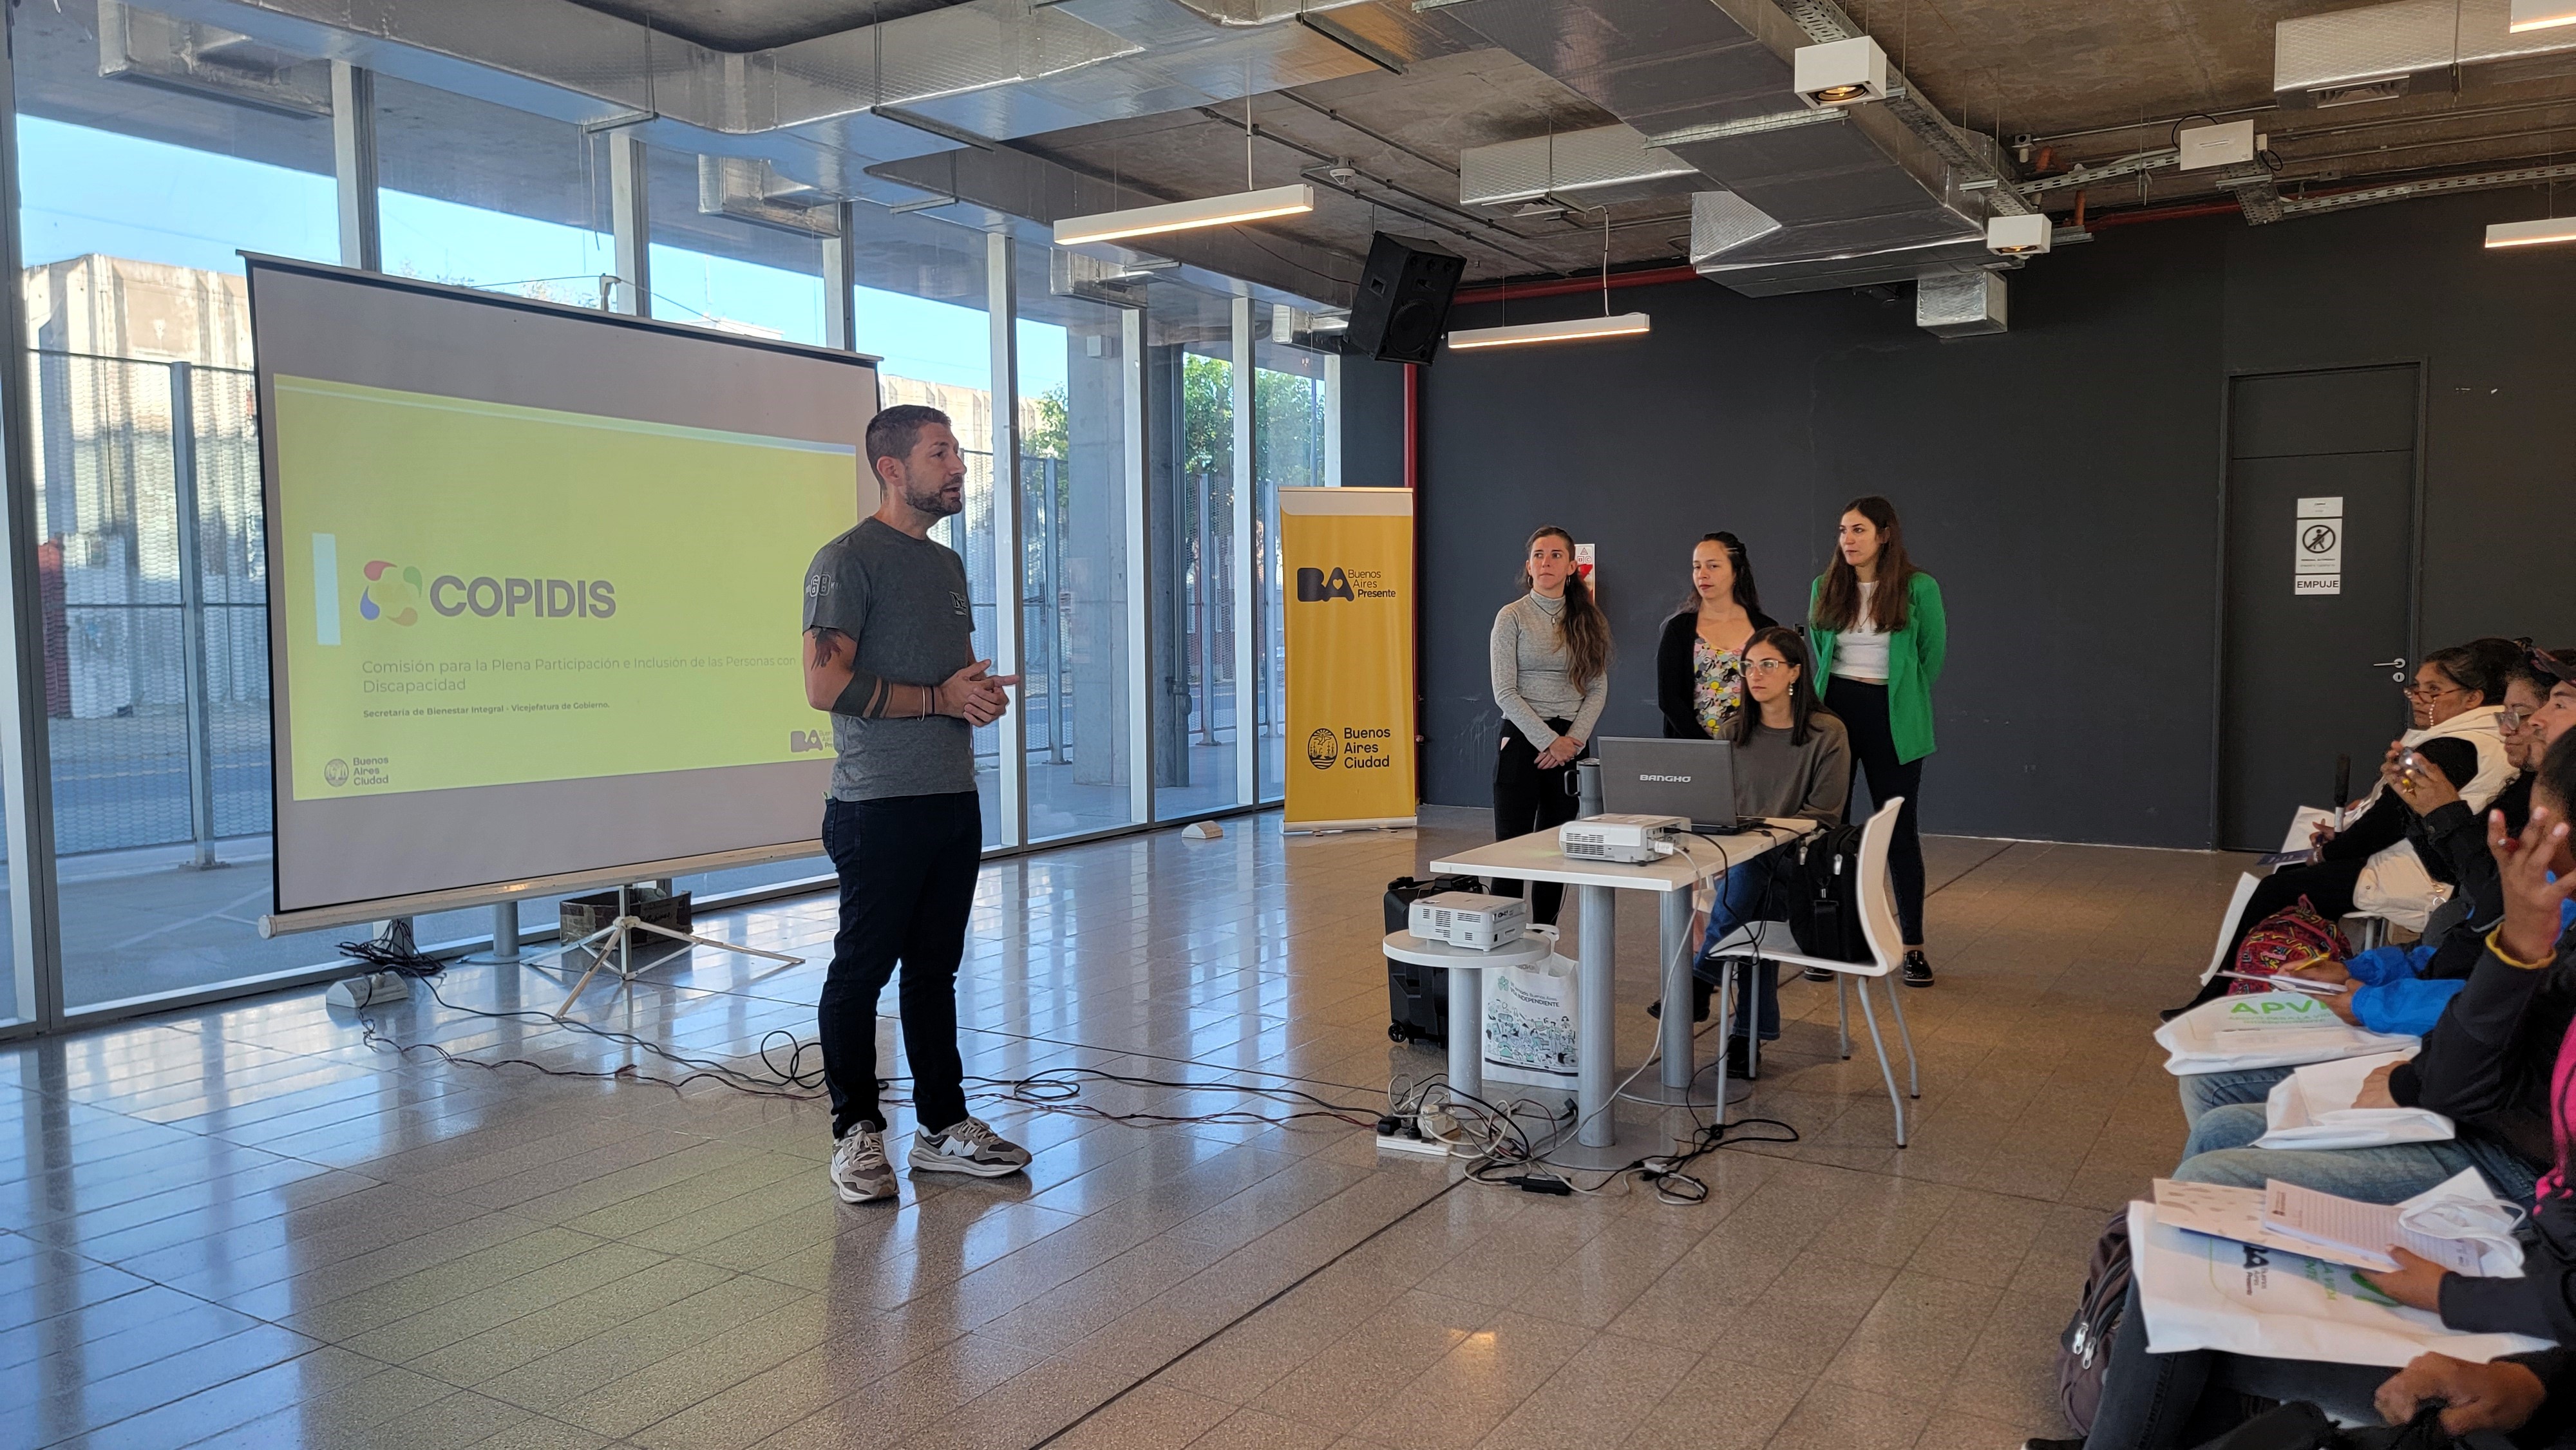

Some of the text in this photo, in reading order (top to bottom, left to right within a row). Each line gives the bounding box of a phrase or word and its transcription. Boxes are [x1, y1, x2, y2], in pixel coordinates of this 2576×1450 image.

[1348, 569, 1381, 578] Buenos
[1353, 579, 1378, 588] Aires
[430, 575, 616, 618] COPIDIS
[1358, 589, 1396, 598] Presente
[362, 656, 796, 675] Comisión para la Plena Participación e Inclusión de las Personas con
[363, 679, 466, 694] Discapacidad
[363, 709, 410, 718] Secretaría
[413, 707, 424, 715] de
[427, 706, 469, 715] Bienestar
[471, 705, 504, 714] Integral
[511, 704, 559, 713] Vicejefatura
[1344, 727, 1390, 739] Buenos
[1344, 742, 1379, 754] Aires
[354, 757, 388, 766] Buenos
[1344, 755, 1390, 769] Ciudad
[354, 767, 379, 776] Aires
[354, 775, 388, 786] Ciudad
